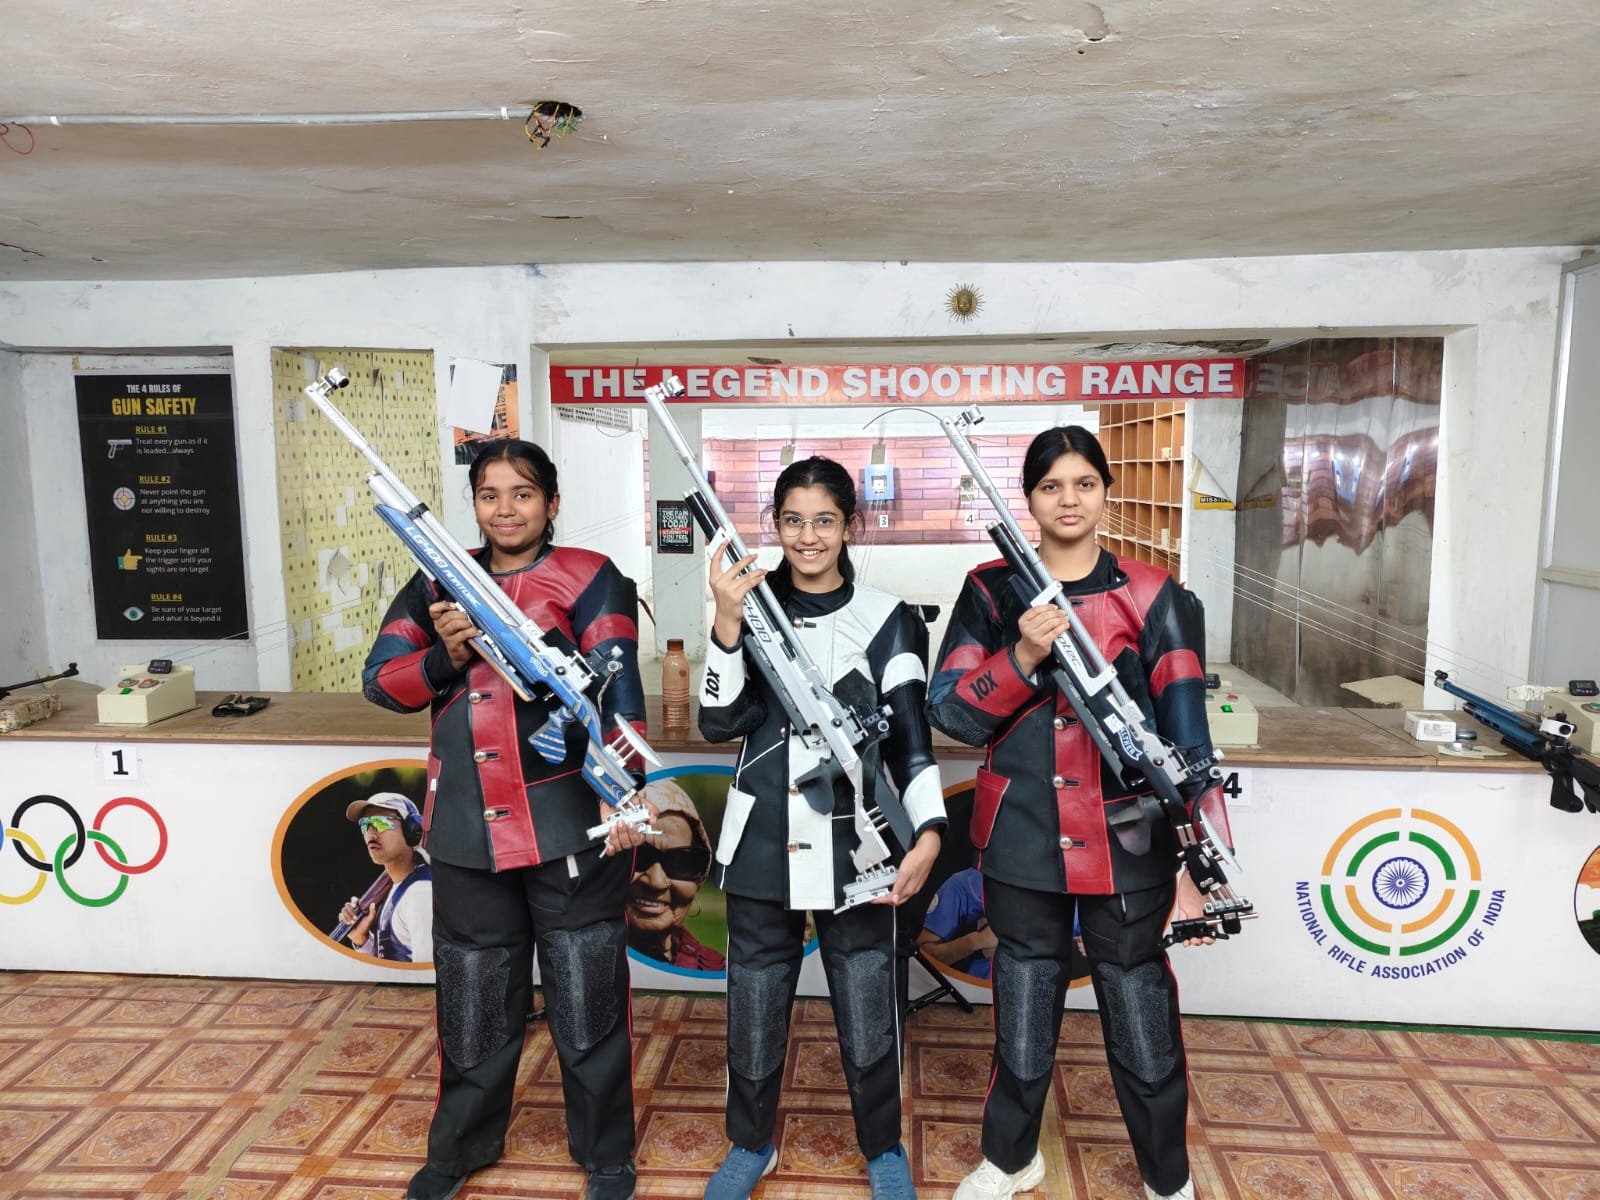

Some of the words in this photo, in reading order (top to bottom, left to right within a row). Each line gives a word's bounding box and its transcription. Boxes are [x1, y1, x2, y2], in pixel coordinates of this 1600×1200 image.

[565, 368, 647, 397] THE
[842, 365, 1066, 398] SHOOTING
[1082, 363, 1234, 396] RANGE
[126, 384, 140, 393] THE
[141, 384, 147, 393] 4
[148, 384, 171, 393] RULES
[172, 384, 182, 393] OF
[111, 398, 141, 415] GUN
[145, 397, 196, 415] SAFETY
[135, 425, 156, 433] RULE
[157, 425, 167, 433] #1
[174, 439, 187, 447] gun
[139, 475, 159, 484] RULE
[160, 475, 171, 484] #2
[161, 488, 179, 496] point
[149, 498, 178, 506] anything
[154, 507, 176, 515] willing
[185, 507, 210, 515] destroy
[662, 519, 688, 528] TODAY
[881, 516, 887, 526] 3
[966, 514, 973, 524] 4
[145, 534, 166, 542] RULE
[167, 534, 177, 542] #3
[179, 547, 198, 555] finger
[405, 526, 448, 568] LG400
[157, 557, 179, 565] trigger
[196, 557, 212, 565] your
[146, 566, 165, 574] sights
[189, 566, 209, 574] target
[151, 593, 171, 601] RULE
[172, 593, 182, 601] #4
[201, 606, 222, 614] target
[190, 615, 216, 623] beyond
[705, 666, 721, 701] 10X
[970, 670, 999, 702] 10X
[1120, 725, 1137, 755] ALTHER
[111, 749, 129, 775] 1
[1222, 772, 1243, 799] 4
[1295, 881, 1329, 947] NATIONAL
[1327, 944, 1367, 974] RIFLE
[1371, 946, 1468, 980] ASSOCIATION
[1467, 928, 1486, 948] OF
[1481, 888, 1507, 927] INDIA
